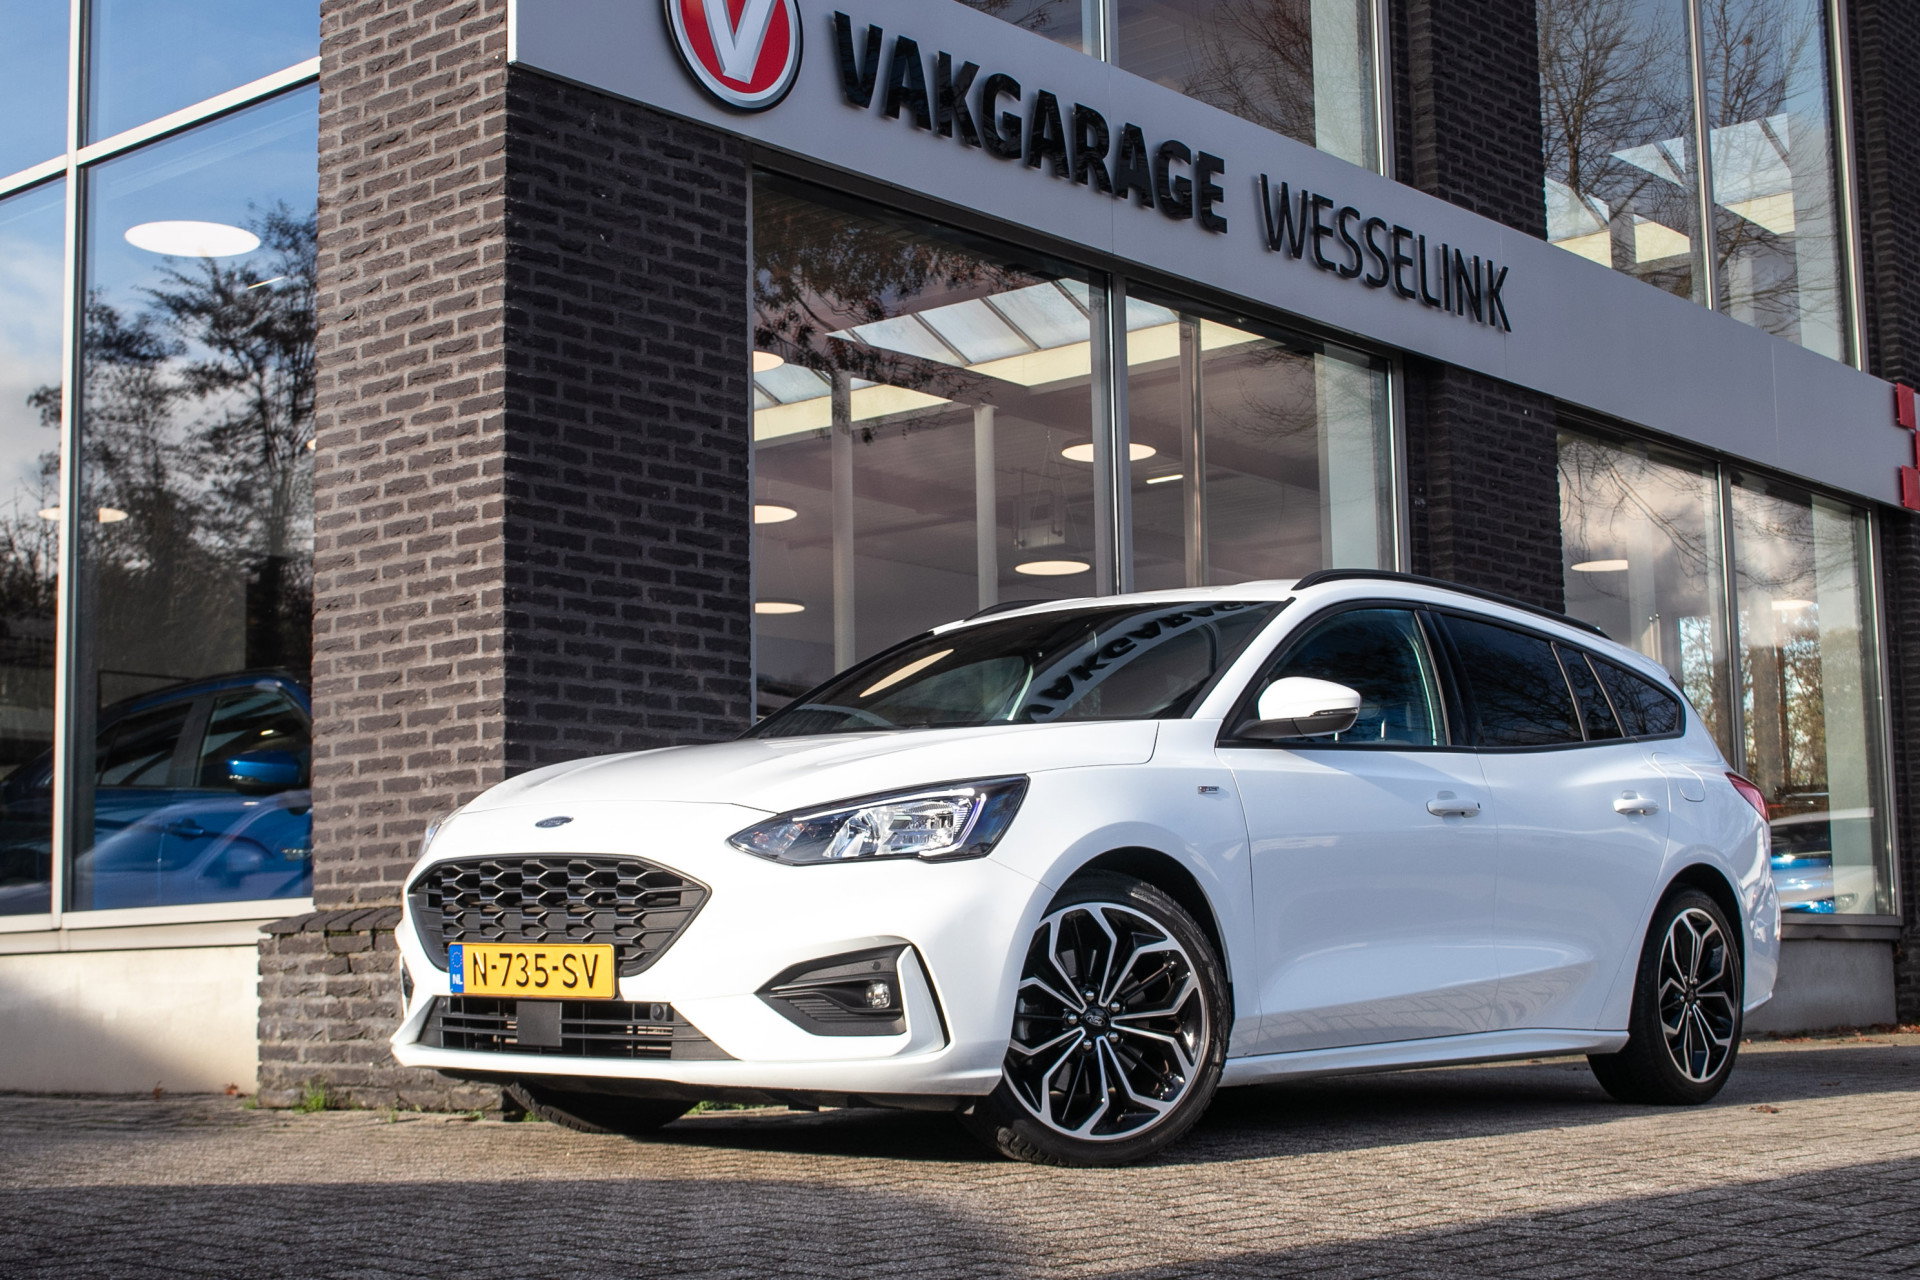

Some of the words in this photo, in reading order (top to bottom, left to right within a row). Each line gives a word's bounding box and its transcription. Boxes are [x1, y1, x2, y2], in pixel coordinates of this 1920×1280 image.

[701, 0, 779, 85] V
[833, 10, 1228, 234] VAKGARAGE
[1260, 173, 1512, 333] WESSELINK
[452, 973, 464, 985] NL
[473, 951, 599, 989] N-735-SV
